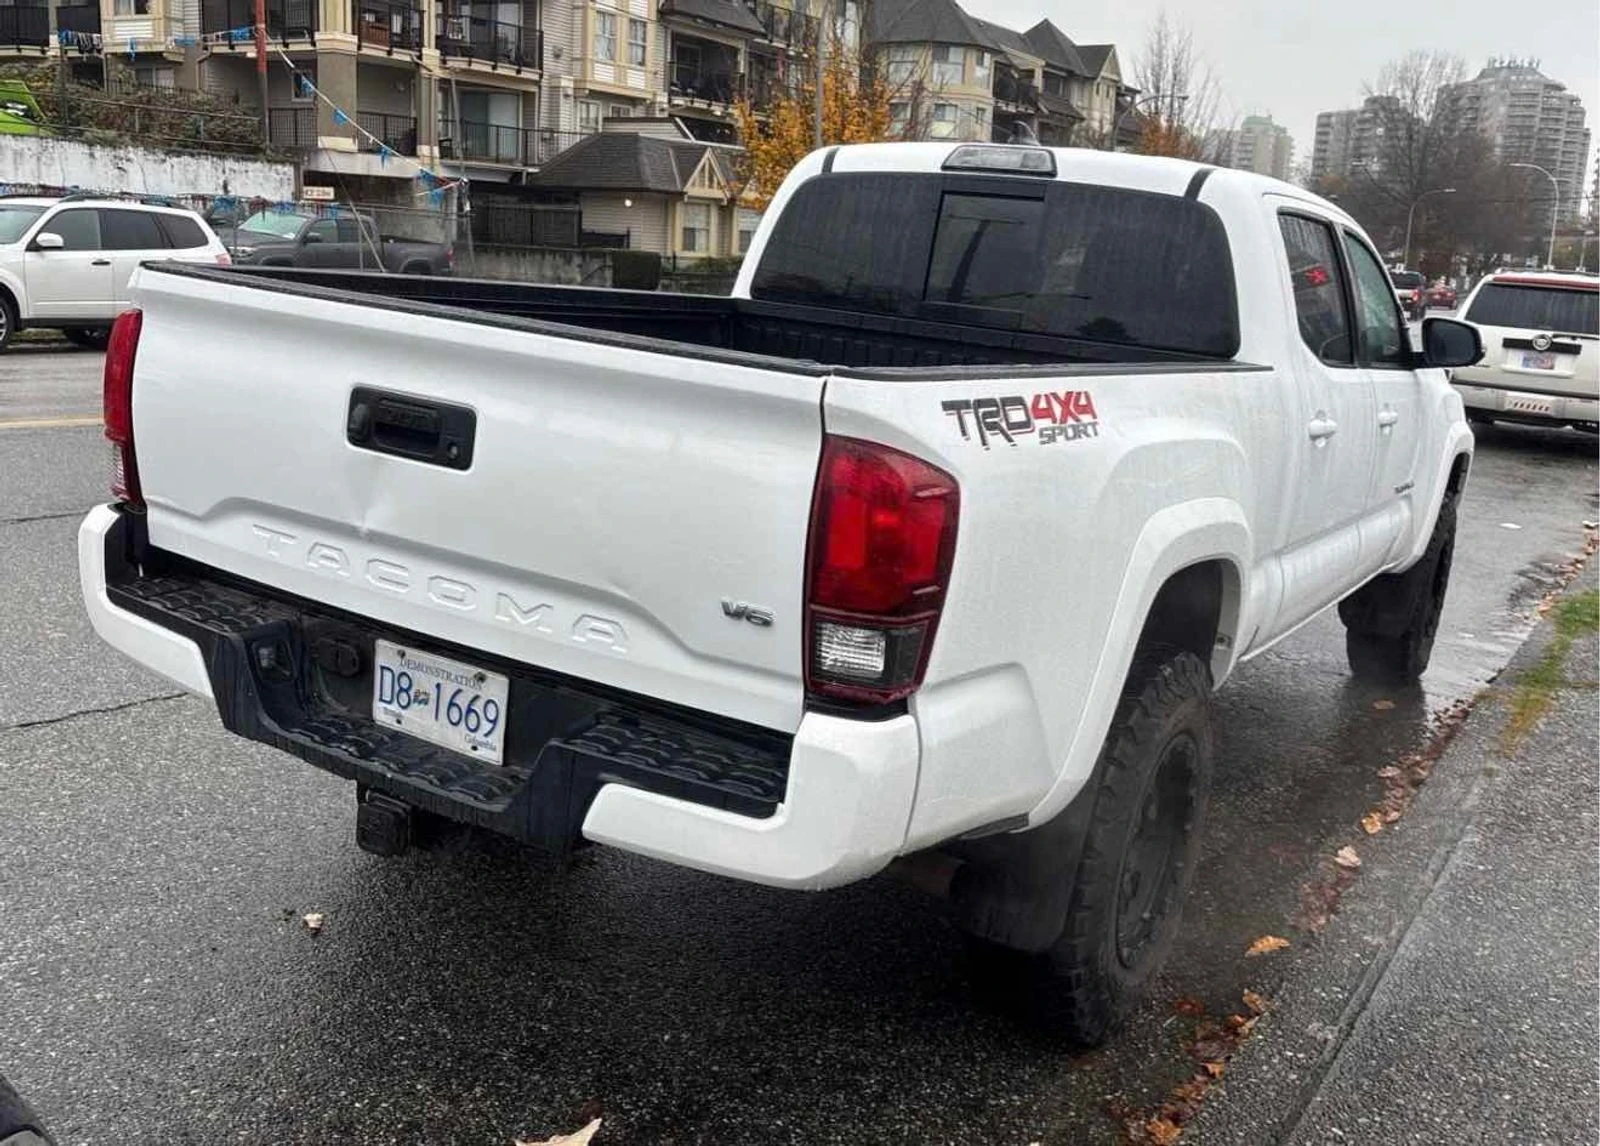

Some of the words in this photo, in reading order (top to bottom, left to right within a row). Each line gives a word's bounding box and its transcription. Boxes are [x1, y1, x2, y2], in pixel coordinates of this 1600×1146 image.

[941, 395, 1035, 450] TRD
[1030, 390, 1098, 425] 4X4
[1038, 421, 1100, 445] SPORT
[252, 523, 629, 654] TACOMA
[720, 600, 774, 628] V6
[434, 681, 500, 738] 1669
